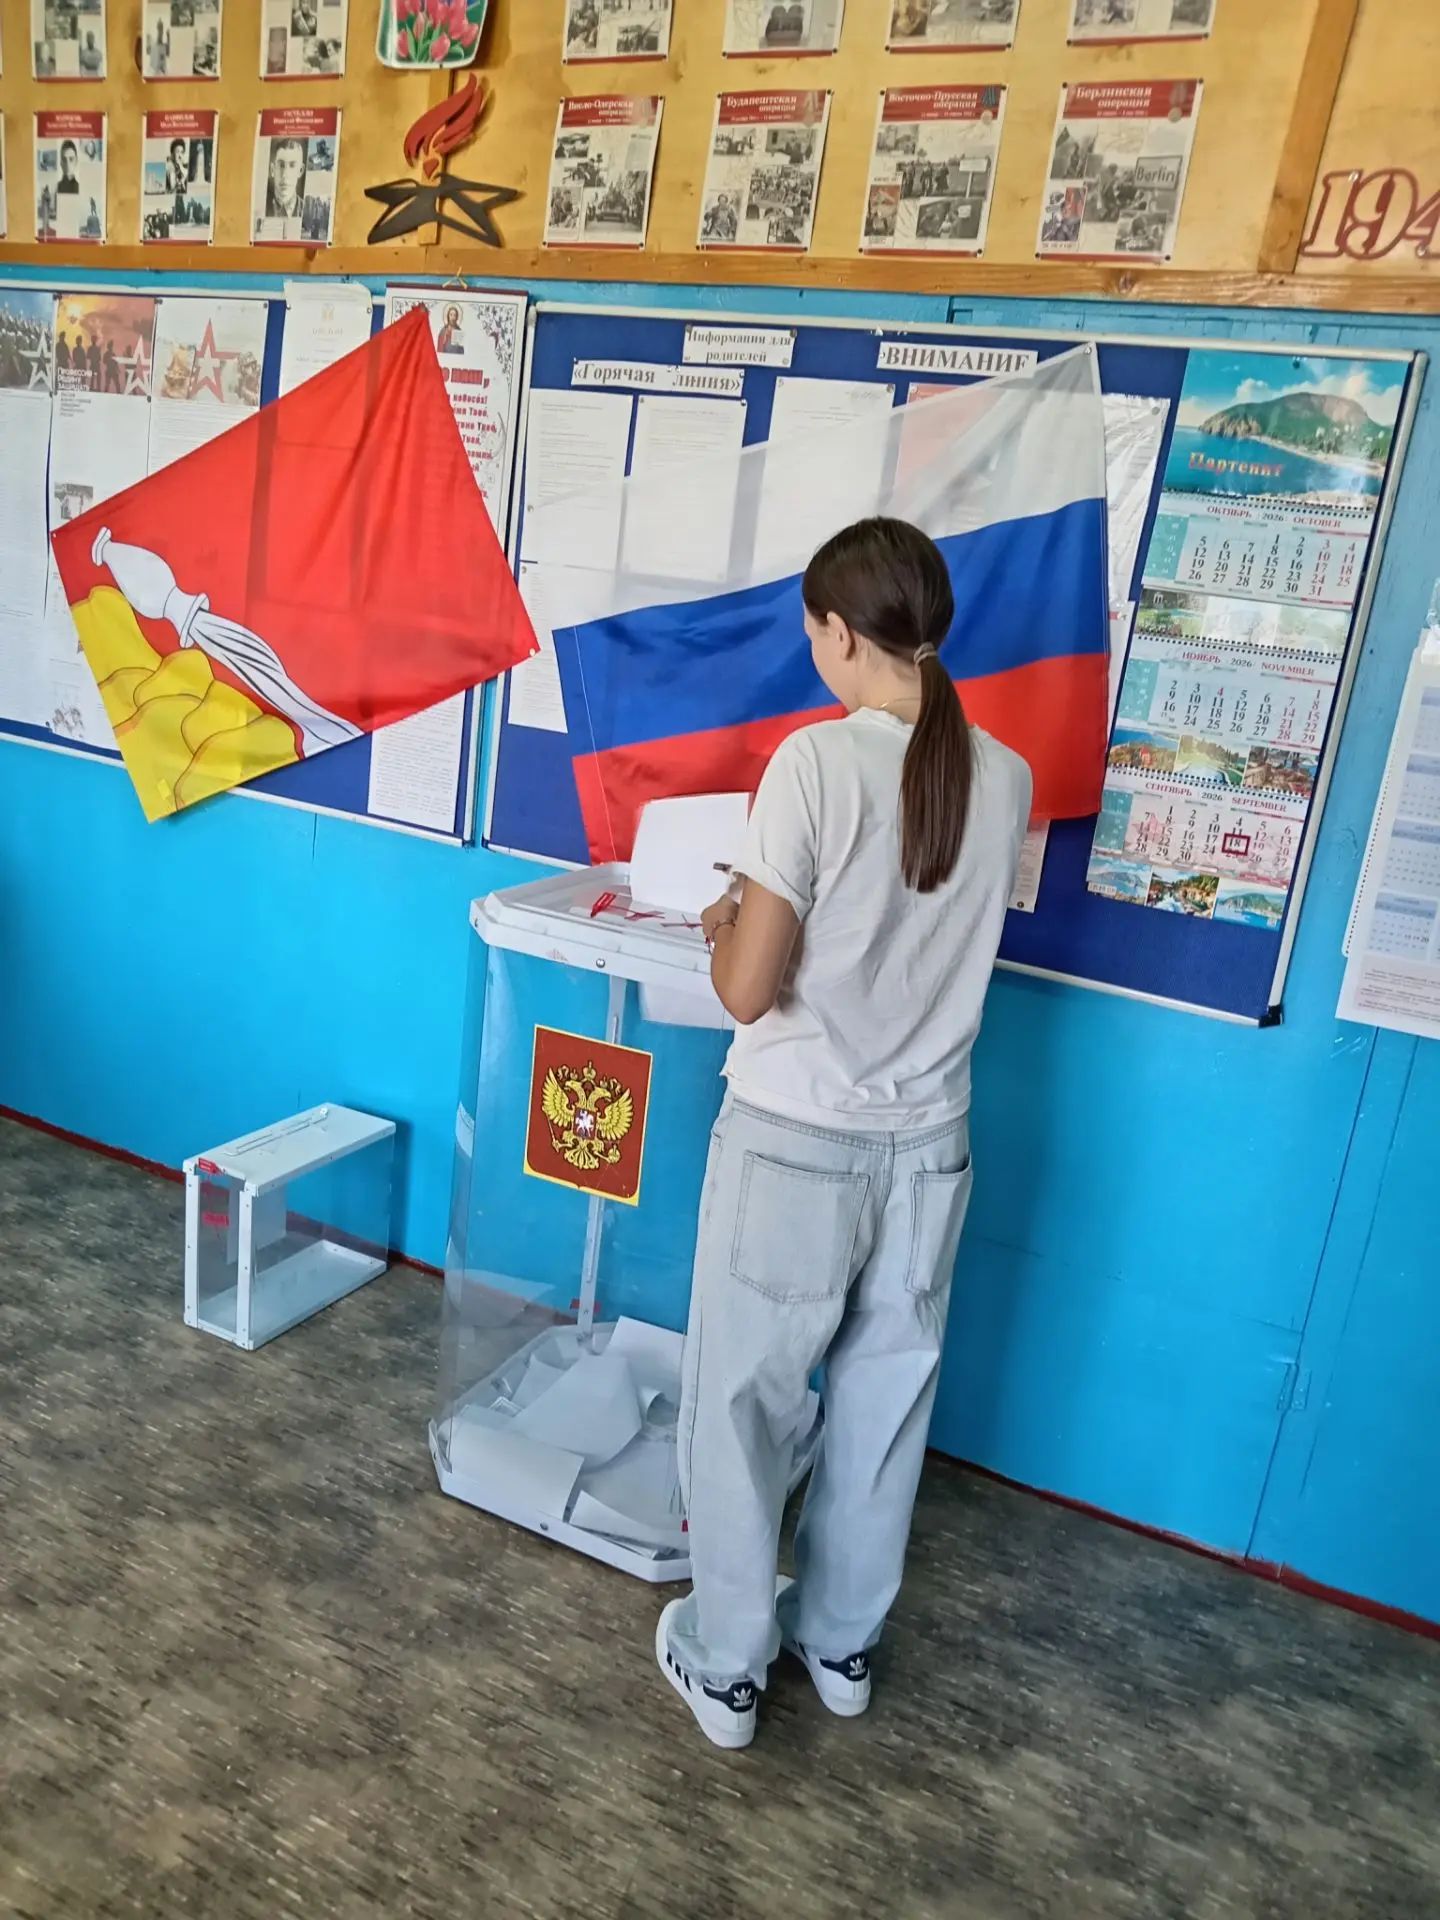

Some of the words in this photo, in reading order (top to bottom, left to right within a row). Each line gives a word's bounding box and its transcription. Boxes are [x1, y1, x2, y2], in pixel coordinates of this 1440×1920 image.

[1136, 165, 1175, 181] Berlin
[688, 330, 766, 346] Информация
[769, 336, 792, 346] для
[706, 351, 768, 364] родителей
[886, 346, 1030, 373] ВНИМАНИЕ
[574, 363, 656, 385] «Горячая
[671, 374, 741, 391] линия»
[1207, 505, 1252, 518] ОКТЯБРЬ
[1263, 513, 1284, 521] 2026
[1293, 516, 1342, 528] OCTOBER
[1199, 536, 1207, 547] 5
[1223, 540, 1230, 549] 6
[1248, 542, 1255, 552] 7
[1271, 545, 1278, 555] 8
[1296, 548, 1303, 557] 9
[1319, 551, 1330, 561] 10
[1344, 553, 1355, 563] 11
[1275, 534, 1280, 544] 1
[1298, 536, 1305, 547] 2
[1323, 540, 1330, 549] 3
[1348, 542, 1355, 552] 4
[1192, 558, 1204, 569] 19
[1214, 562, 1228, 572] 20
[1238, 565, 1252, 576] 21
[1262, 568, 1276, 578] 22
[1286, 571, 1301, 581] 23
[1311, 574, 1325, 584] 24
[1337, 577, 1351, 587] 25
[1195, 547, 1207, 558] 12
[1218, 550, 1231, 561] 13
[1242, 553, 1255, 564] 14
[1266, 556, 1278, 567] 15
[1290, 559, 1303, 570] 16
[1315, 562, 1328, 573] 17
[1341, 565, 1353, 575] 18
[1188, 570, 1202, 580] 26
[1212, 573, 1226, 583] 27
[1236, 576, 1250, 587] 28
[1260, 579, 1274, 590] 29
[1284, 582, 1298, 593] 30
[1308, 585, 1322, 596] 31
[1182, 651, 1221, 664] НОЯБРЬ
[1230, 658, 1252, 668] 2026
[1261, 662, 1314, 676] NOVEMBER
[1169, 690, 1175, 699] 9
[1189, 694, 1201, 704] 10
[1212, 696, 1224, 708] 11
[1235, 700, 1247, 711] 12
[1259, 703, 1272, 714] 13
[1283, 707, 1295, 717] 14
[1308, 711, 1320, 721] 15
[1170, 680, 1178, 690] 2
[1193, 682, 1200, 693] 3
[1217, 687, 1224, 696] 4
[1240, 689, 1248, 700] 5
[1264, 693, 1271, 703] 6
[1289, 696, 1295, 706] 7
[1312, 700, 1320, 710] 8
[1316, 689, 1321, 699] 1
[1163, 701, 1176, 712] 16
[1187, 705, 1199, 715] 17
[1210, 707, 1222, 718] 18
[1233, 711, 1245, 721] 19
[1256, 714, 1269, 725] 20
[1280, 719, 1292, 729] 21
[1304, 722, 1317, 732] 22
[1183, 715, 1197, 726] 24
[1207, 719, 1220, 729] 25
[1230, 722, 1243, 733] 26
[1253, 726, 1267, 736] 27
[1277, 729, 1291, 740] 28
[1301, 733, 1315, 743] 29
[1145, 782, 1192, 797] СЕНТЯБРЬ
[1201, 792, 1223, 801] 2026
[1232, 797, 1287, 812] SEPTEMBER
[1145, 812, 1151, 821] 7
[1165, 816, 1172, 825] 8
[1188, 820, 1195, 829] 9
[1208, 823, 1220, 833] 10
[1232, 827, 1242, 836] 11
[1255, 831, 1267, 842] 12
[1280, 836, 1291, 846] 13
[1169, 805, 1174, 816] 1
[1190, 809, 1197, 819] 2
[1212, 813, 1220, 823] 3
[1235, 817, 1242, 827] 4
[1260, 821, 1267, 831] 5
[1284, 826, 1291, 835] 6
[1158, 837, 1171, 847] 22
[1180, 840, 1193, 850] 23
[1202, 844, 1216, 855] 24
[1161, 826, 1173, 836] 15
[1184, 830, 1195, 840] 16
[1206, 834, 1218, 844] 17
[1229, 838, 1241, 848] 18
[1135, 843, 1147, 853] 28
[1156, 847, 1168, 857] 29
[1179, 851, 1191, 861] 30
